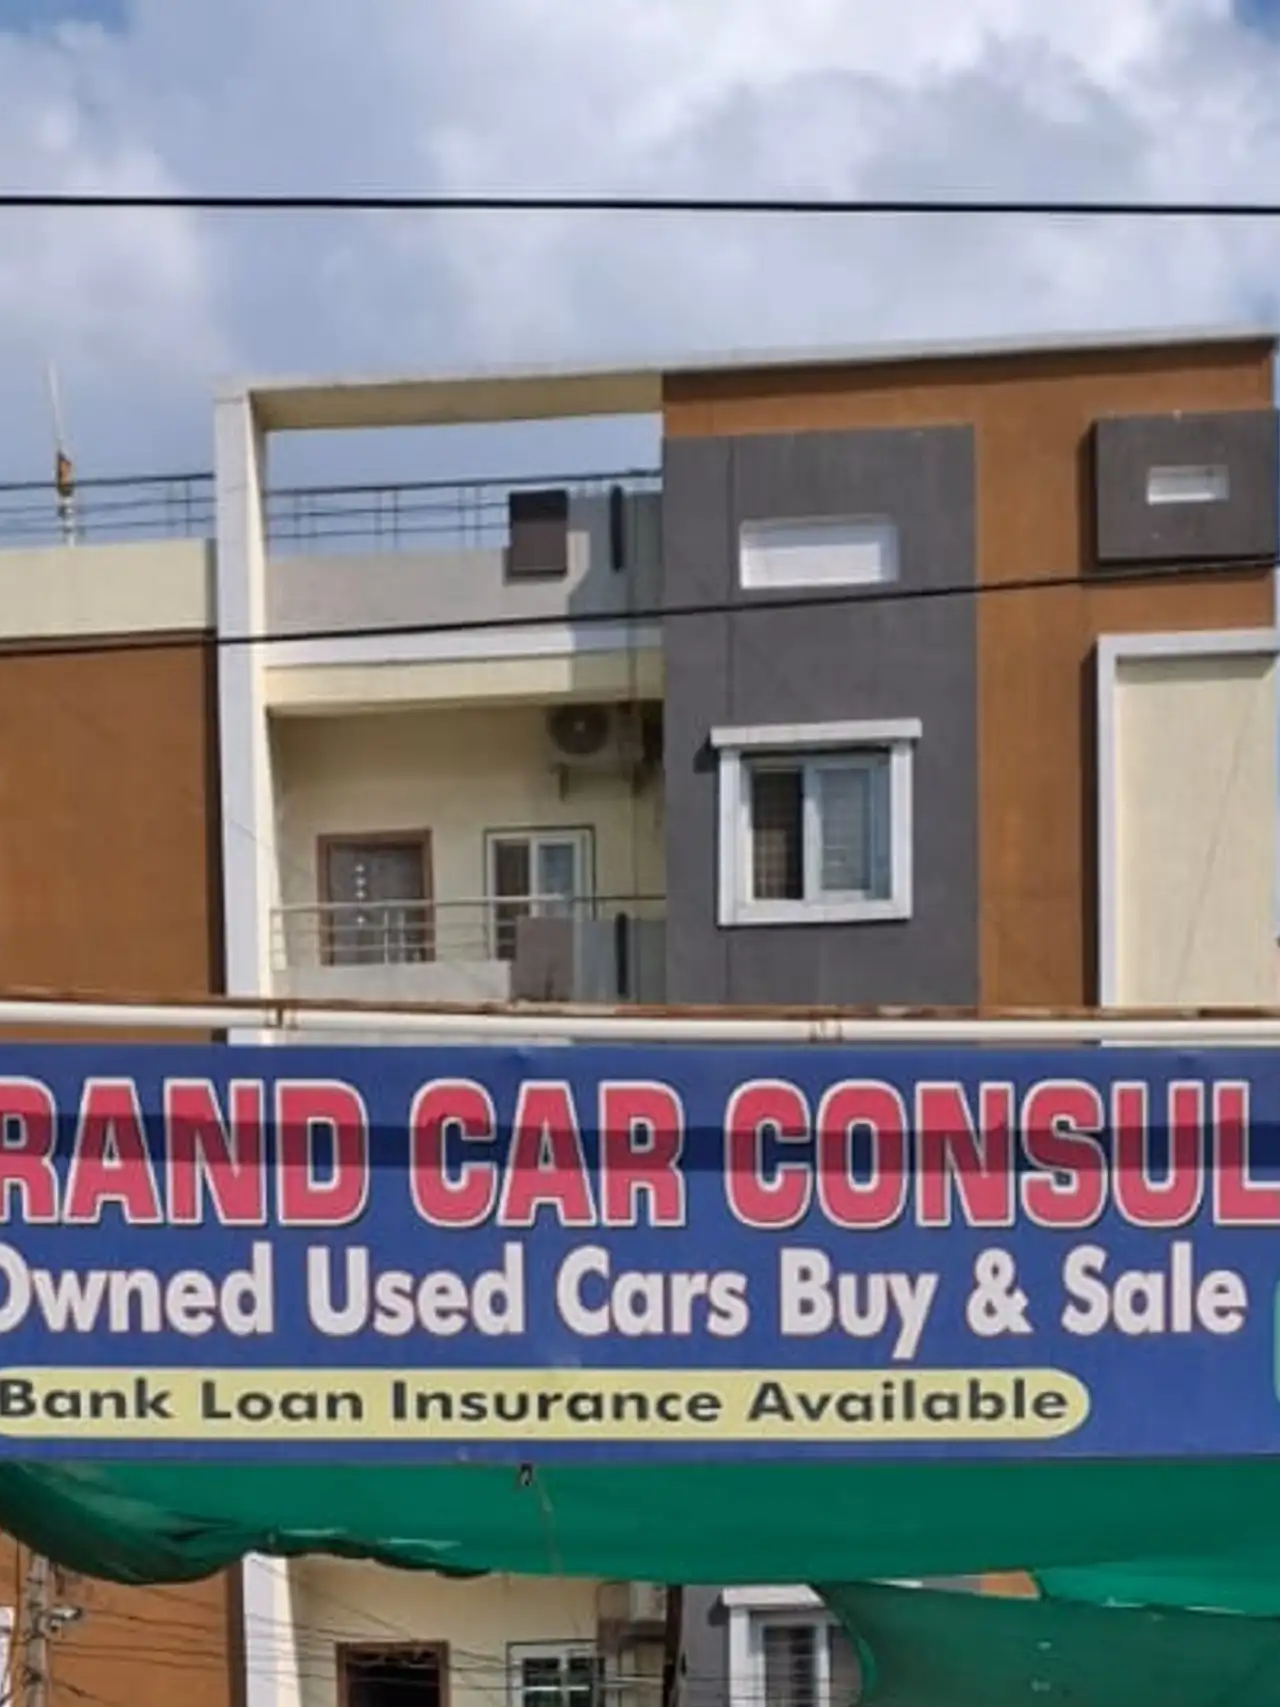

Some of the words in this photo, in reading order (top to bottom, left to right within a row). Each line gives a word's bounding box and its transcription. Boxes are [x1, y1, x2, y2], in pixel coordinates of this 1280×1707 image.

[409, 1078, 686, 1228] CAR
[307, 1241, 525, 1335] Used
[557, 1246, 749, 1336] Cars
[780, 1247, 938, 1360] Buy
[966, 1247, 1033, 1336] &
[1061, 1241, 1248, 1335] Sale
[202, 1379, 363, 1420] Loan
[392, 1379, 722, 1421] Insurance
[748, 1378, 1068, 1421] Available
